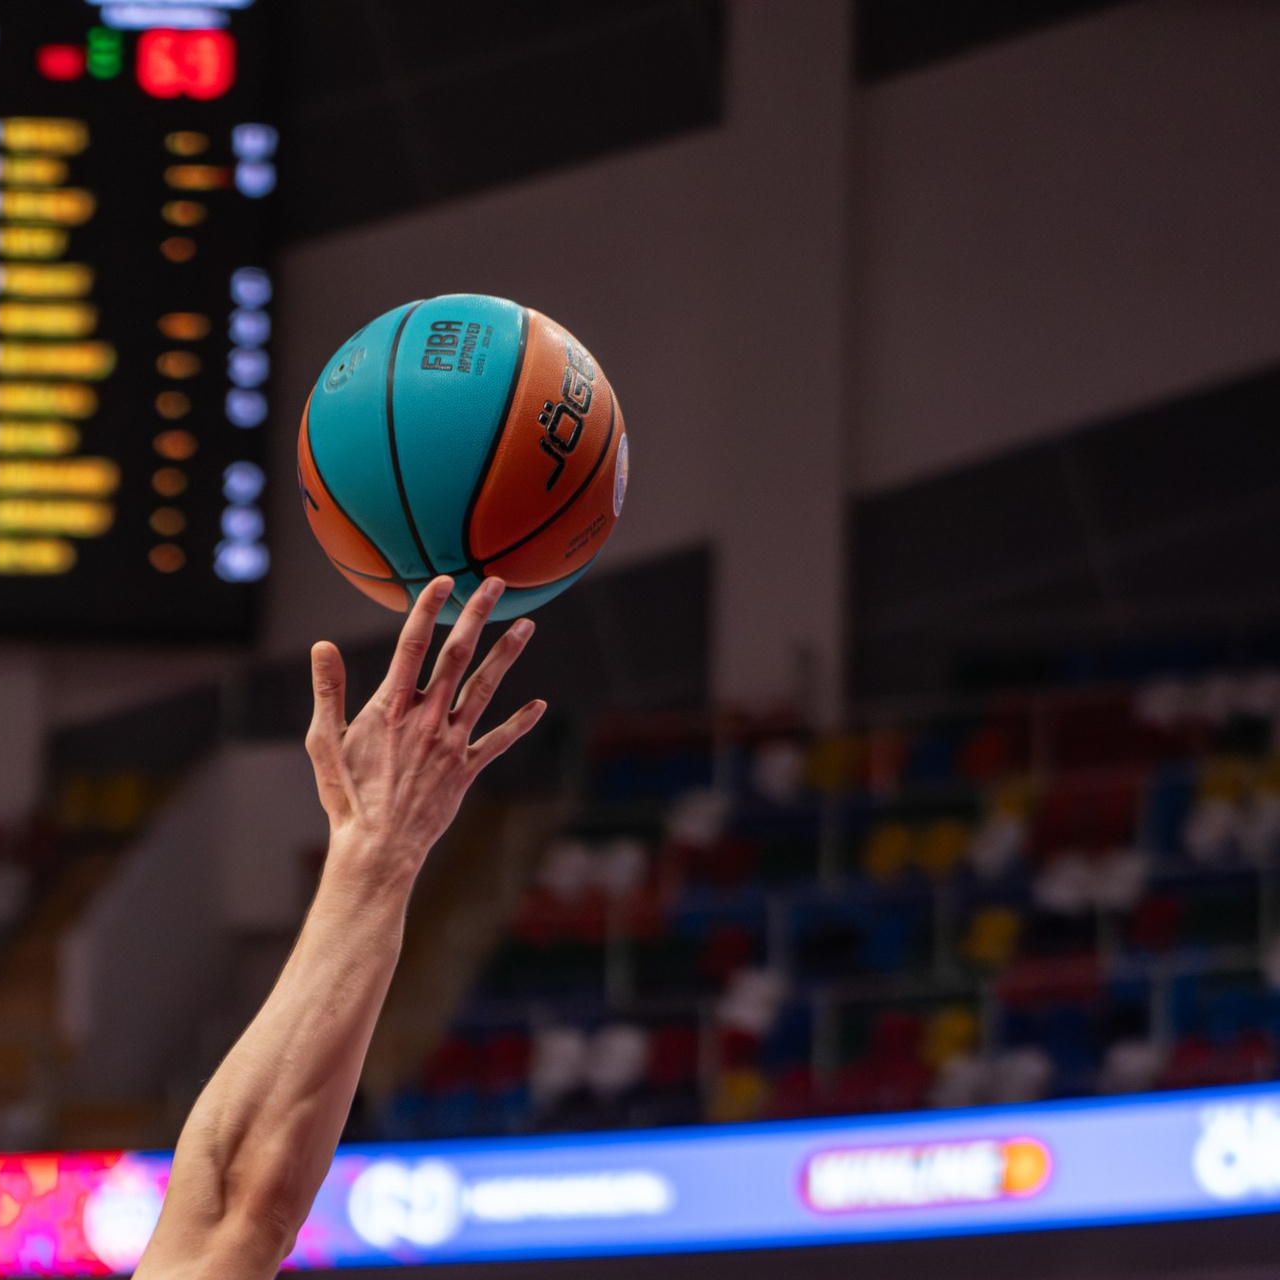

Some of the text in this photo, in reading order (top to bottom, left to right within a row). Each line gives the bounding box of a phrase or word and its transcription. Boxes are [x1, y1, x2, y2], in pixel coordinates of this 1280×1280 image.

[421, 320, 463, 371] FIBA
[457, 322, 481, 374] APPROVED
[537, 331, 594, 493] JÖGE
